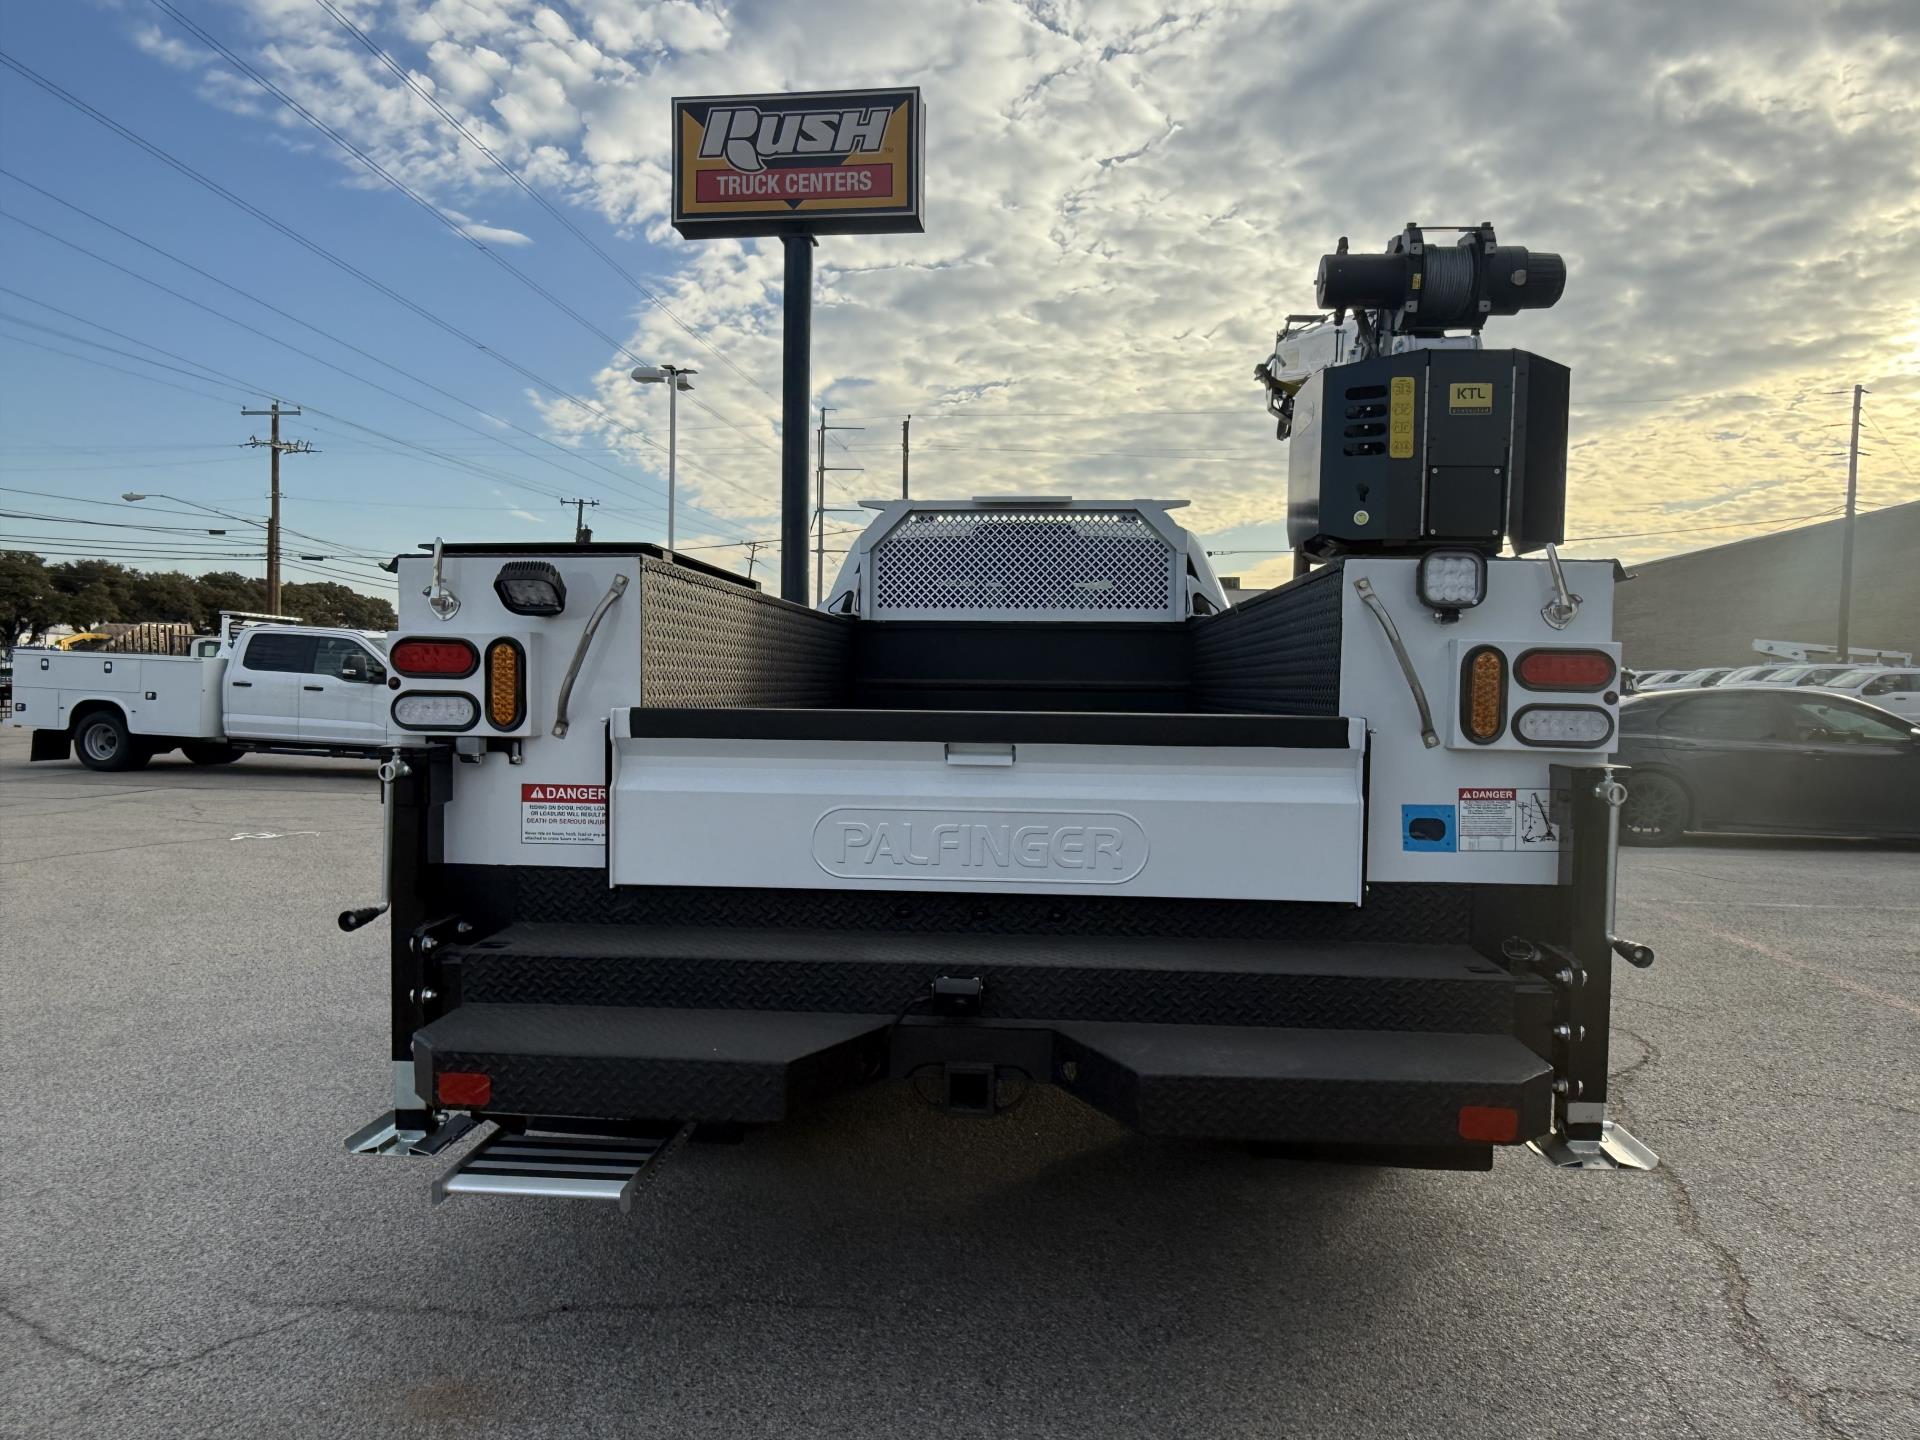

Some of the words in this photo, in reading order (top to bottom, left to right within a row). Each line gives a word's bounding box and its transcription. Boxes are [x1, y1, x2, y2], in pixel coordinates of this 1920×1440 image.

[697, 106, 894, 175] RUSH
[716, 174, 782, 196] TRUCK
[785, 171, 873, 194] CENTERS
[1457, 387, 1487, 400] KTL
[546, 787, 605, 800] DANGER
[1472, 790, 1513, 799] DANGER
[834, 820, 1124, 870] PALFINGER
